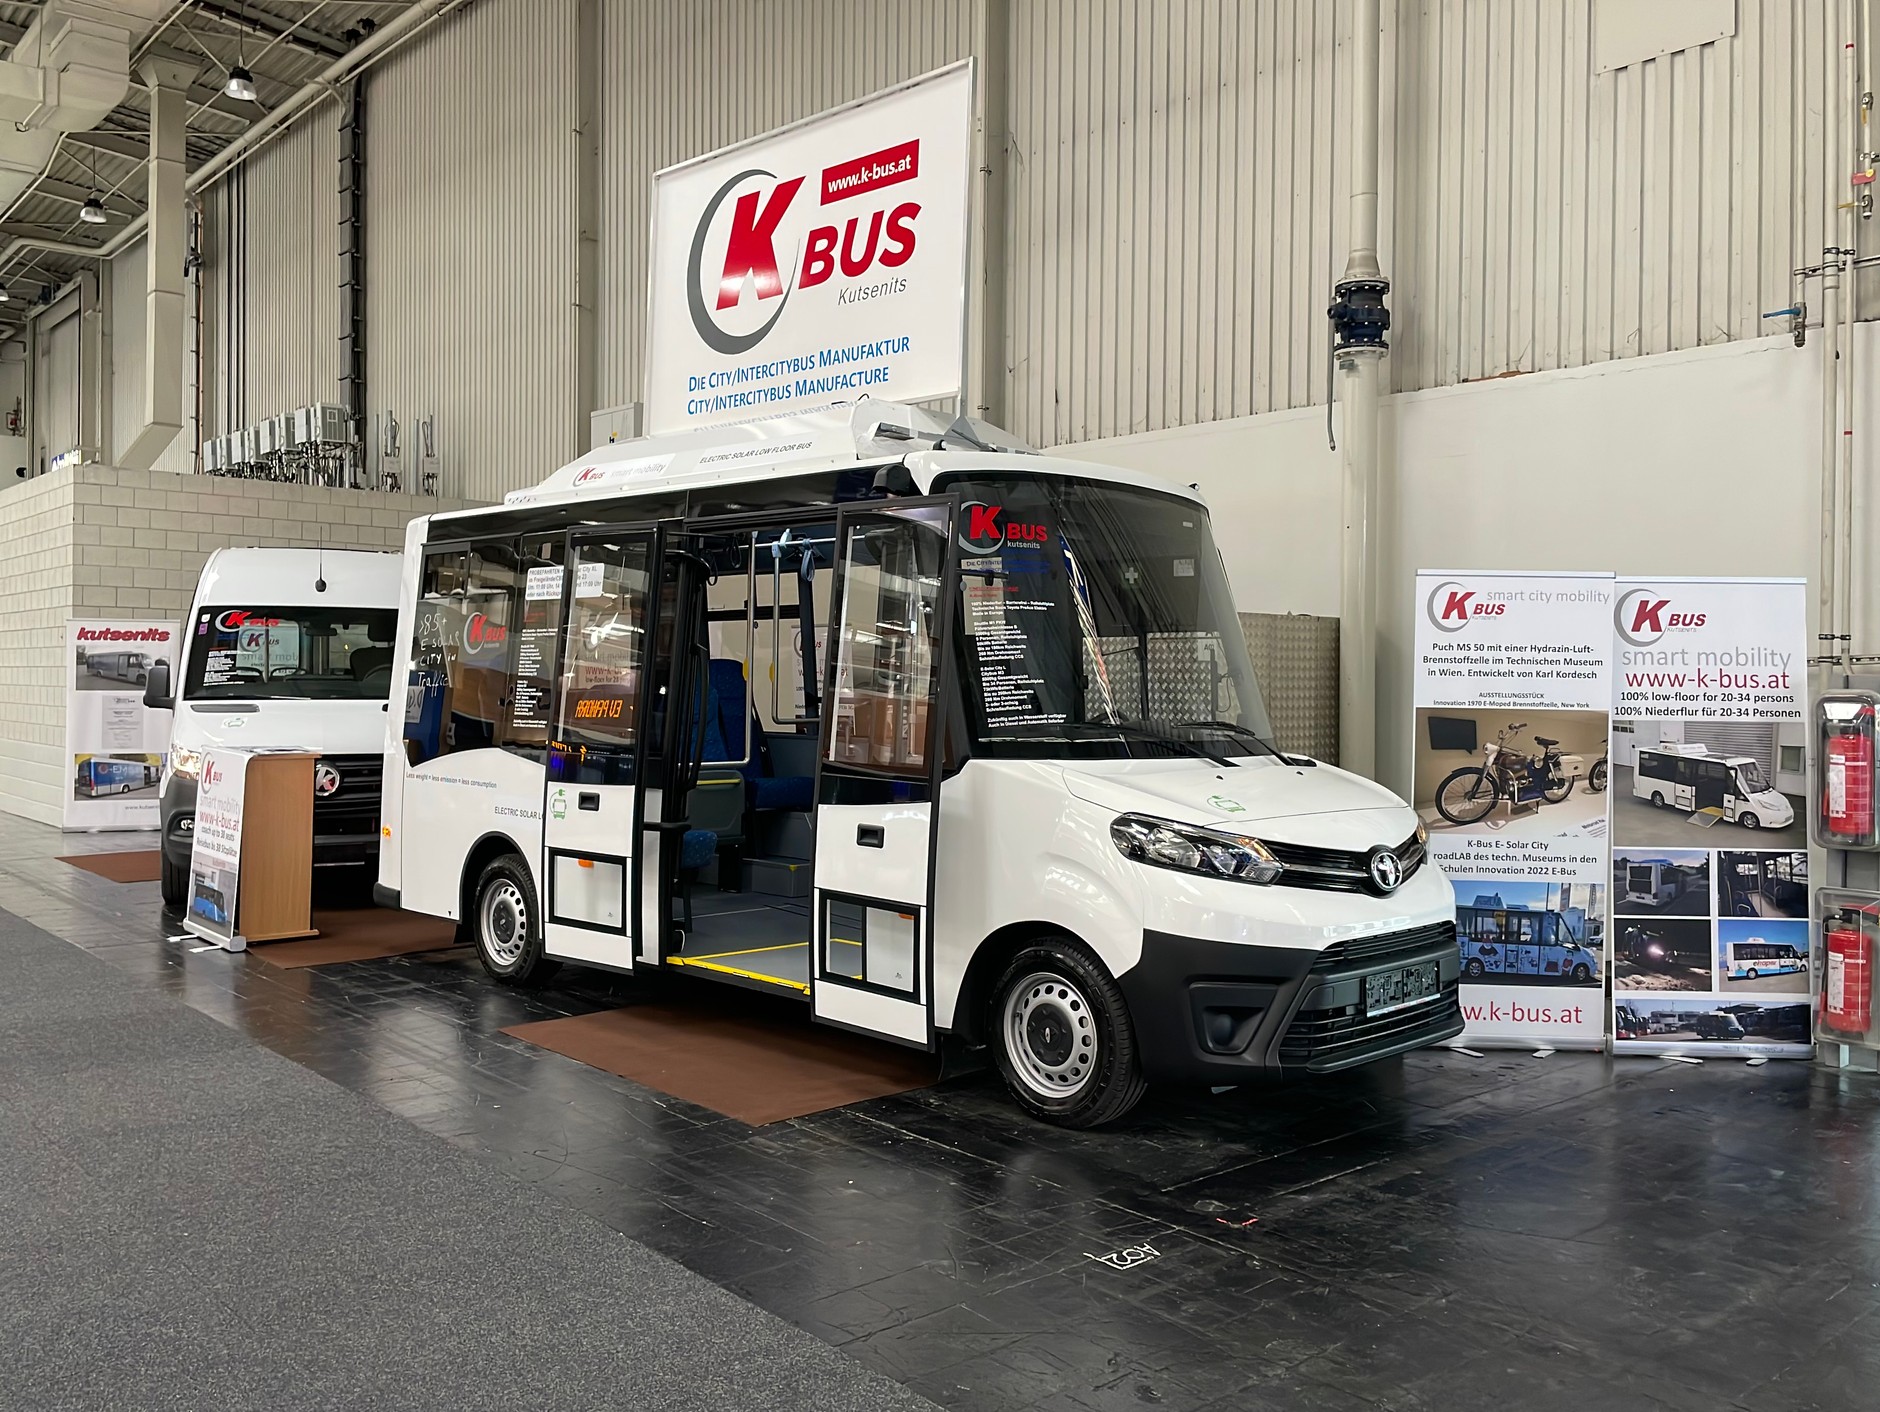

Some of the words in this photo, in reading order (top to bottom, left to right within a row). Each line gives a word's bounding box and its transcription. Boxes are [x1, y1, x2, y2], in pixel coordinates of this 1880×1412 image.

[827, 155, 911, 193] www.k-bus.at
[716, 176, 806, 310] K
[798, 202, 922, 289] BUS
[837, 277, 907, 305] Kutsenits
[688, 375, 706, 392] DIE
[819, 337, 910, 367] MANUFAKTUR
[795, 367, 889, 398] MANUFACTURE
[700, 454, 731, 463] ELECTRIC
[732, 450, 755, 459] SOLAR
[772, 444, 796, 453] FLOOR
[578, 468, 596, 481] K
[634, 464, 666, 474] mobility
[969, 505, 1002, 539] K
[1007, 523, 1047, 541] BUS
[1007, 540, 1040, 549] kutsenits
[1487, 591, 1524, 601] smart
[1529, 591, 1552, 604] city
[1556, 590, 1610, 604] mobility
[1442, 592, 1476, 619] K
[1473, 603, 1505, 615] BUS
[225, 611, 252, 626] K
[1631, 600, 1671, 632] K
[1668, 614, 1706, 626] BUS
[77, 627, 170, 642] kutsenits
[470, 615, 487, 642] K
[485, 627, 506, 640] BUS
[247, 633, 263, 647] K
[421, 638, 428, 650] E
[1432, 643, 1454, 651] Puch
[1457, 643, 1471, 651] MS
[1487, 644, 1502, 652] mit
[1504, 644, 1528, 652] einer
[1530, 645, 1594, 654] Hydrazin-Luft-
[420, 654, 441, 666] CITY
[1423, 656, 1490, 665] Brennstoffzelle
[1492, 657, 1503, 665] im
[1506, 657, 1561, 665] Technischen
[1563, 658, 1603, 666] Museum
[1622, 648, 1688, 665] smart
[1698, 647, 1791, 672] mobility
[1428, 668, 1436, 676] in
[1438, 669, 1465, 677] Wien.
[1467, 669, 1514, 678] Entwickelt
[1536, 670, 1553, 678] Karl
[1556, 670, 1597, 679] Kordesch
[1626, 668, 1790, 689] www-k-bus.at
[418, 670, 449, 697] Traffic
[1621, 692, 1648, 701] 100%
[1652, 692, 1699, 701] low-floor
[1703, 693, 1718, 701] for
[1721, 693, 1750, 702] 20-34
[1754, 695, 1794, 704] persons
[1615, 707, 1642, 716] 100%
[1645, 707, 1699, 716] Niederflur
[1702, 707, 1717, 716] für
[1720, 708, 1749, 717] 20-34
[1753, 709, 1801, 717] Personen
[204, 760, 215, 784] K
[471, 780, 497, 789] consumption
[200, 796, 217, 808] smart
[218, 798, 240, 815] mobility
[495, 806, 518, 817] ELECTRIC
[520, 809, 537, 819] SOLAR
[1467, 840, 1493, 849] K-Bus
[1496, 840, 1504, 849] E-
[1507, 841, 1529, 849] Solar
[1531, 841, 1549, 851] City
[1433, 852, 1470, 860] roadLAB
[1473, 853, 1489, 861] des
[1491, 853, 1520, 862] techn.
[1522, 854, 1566, 863] Museums
[1569, 855, 1577, 863] in
[1580, 855, 1597, 864] den
[1476, 866, 1525, 875] Innovation
[1527, 867, 1549, 875] 2022
[1552, 867, 1577, 876] E-Bus
[1460, 1001, 1583, 1024] w.k-bus.at
